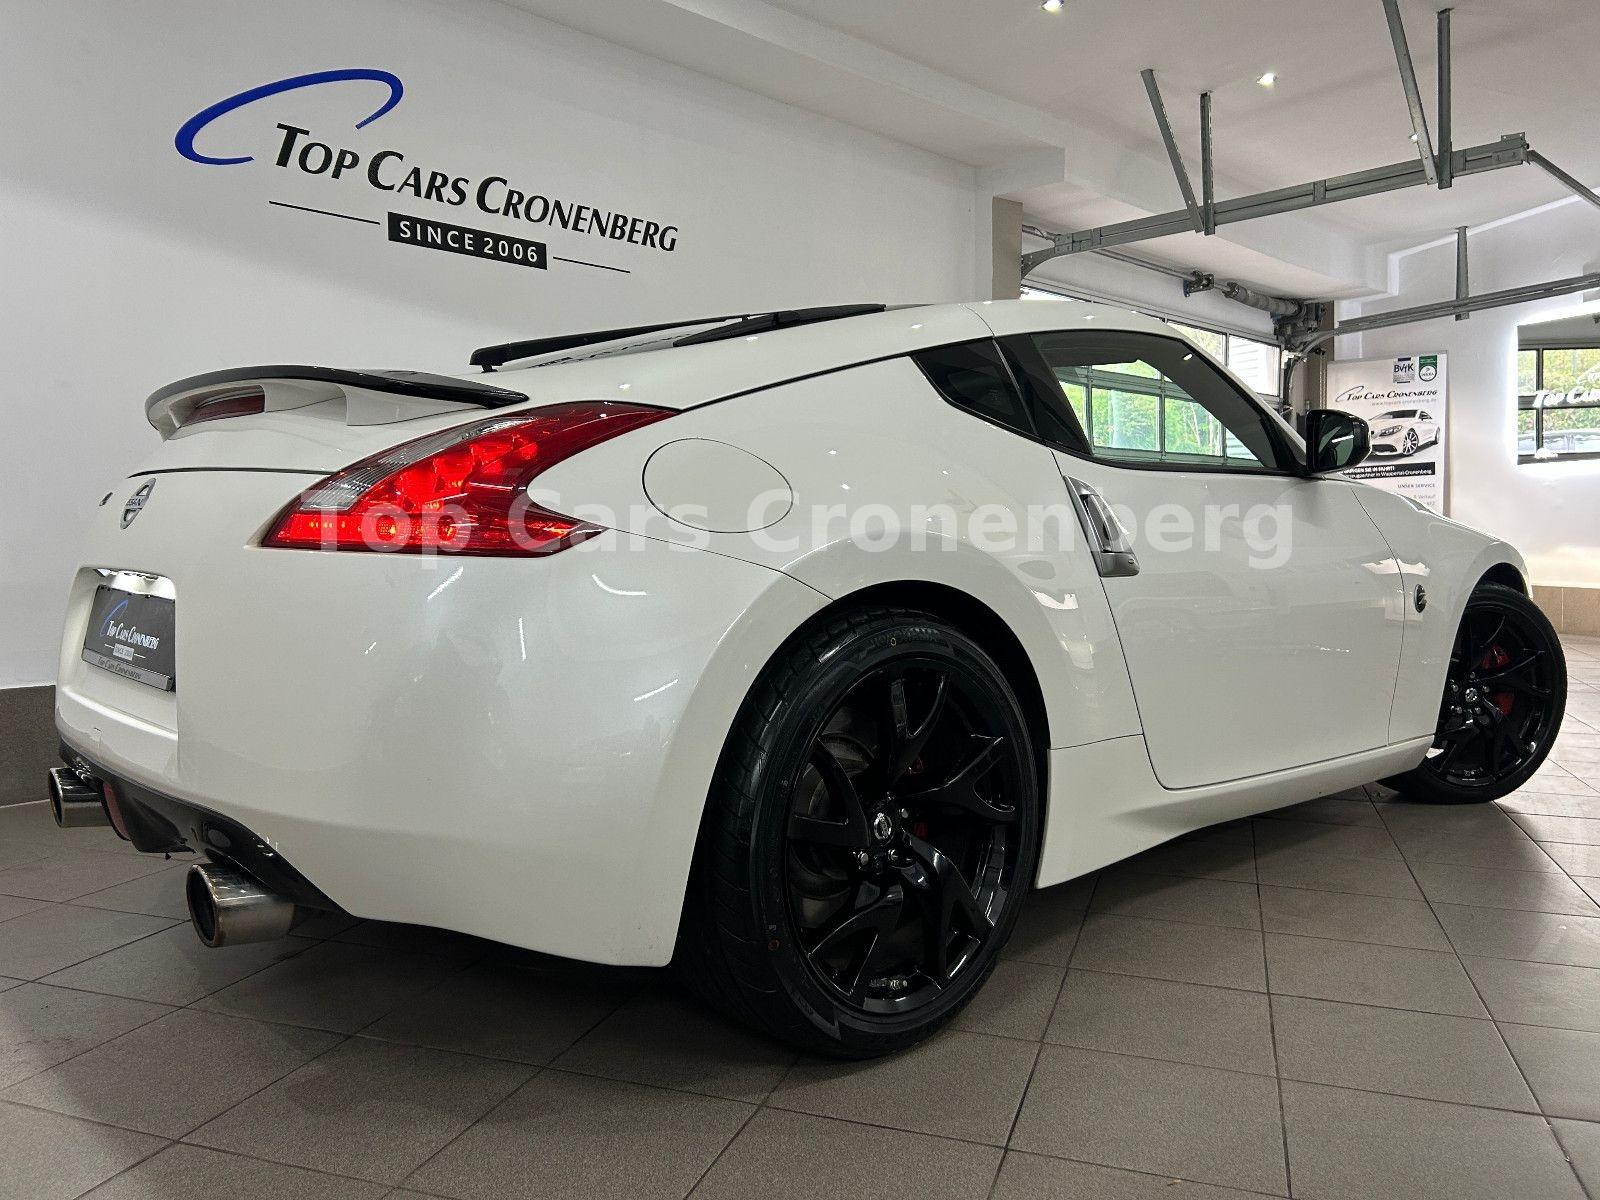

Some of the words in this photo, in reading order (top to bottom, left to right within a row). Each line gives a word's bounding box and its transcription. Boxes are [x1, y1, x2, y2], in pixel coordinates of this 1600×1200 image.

[276, 122, 360, 180] TOP
[367, 150, 470, 206] CARS
[476, 176, 679, 252] CRONENBERG
[399, 220, 475, 250] SINCE
[483, 237, 539, 262] 2006
